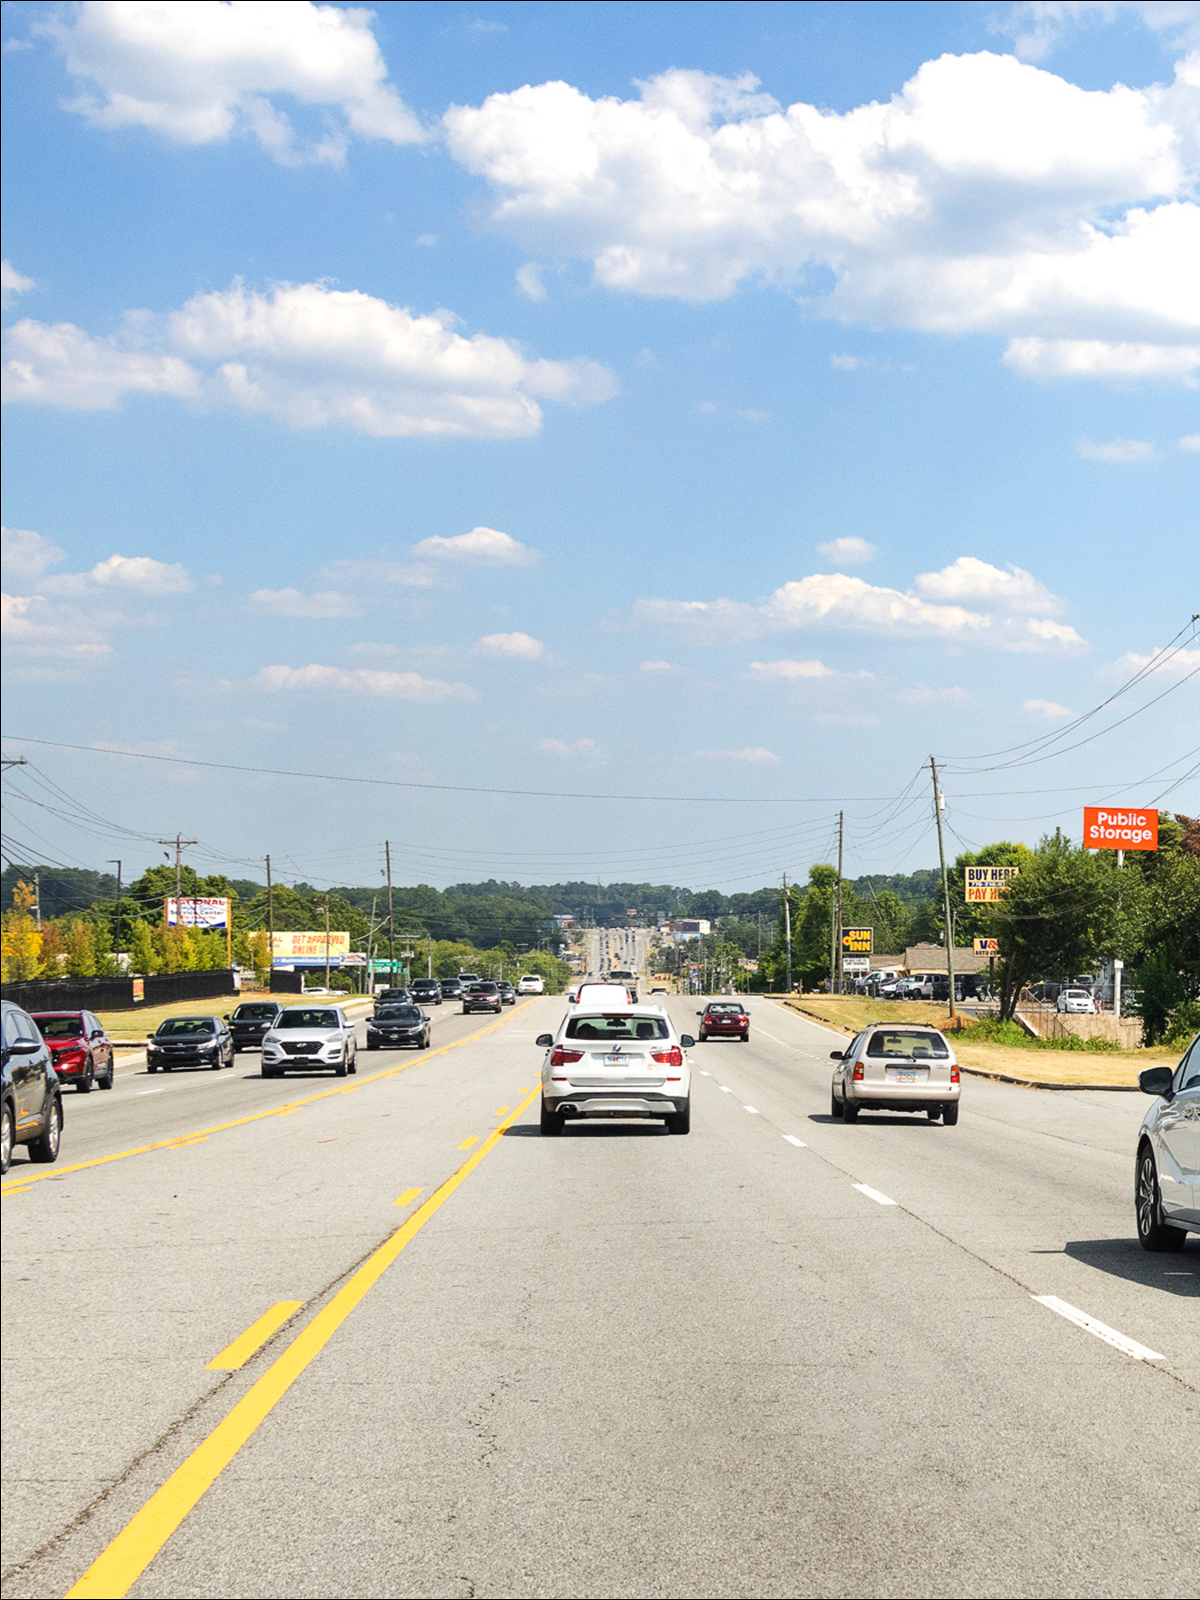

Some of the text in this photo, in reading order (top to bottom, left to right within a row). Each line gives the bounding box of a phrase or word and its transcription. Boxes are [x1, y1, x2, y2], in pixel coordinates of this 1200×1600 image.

[1097, 812, 1147, 827] Public
[1089, 825, 1153, 844] Storage
[968, 869, 989, 881] BUY
[968, 888, 987, 900] PAY
[291, 935, 307, 945] GET
[849, 930, 871, 940] SUN
[291, 945, 317, 955] ONLINE
[850, 941, 871, 951] INN
